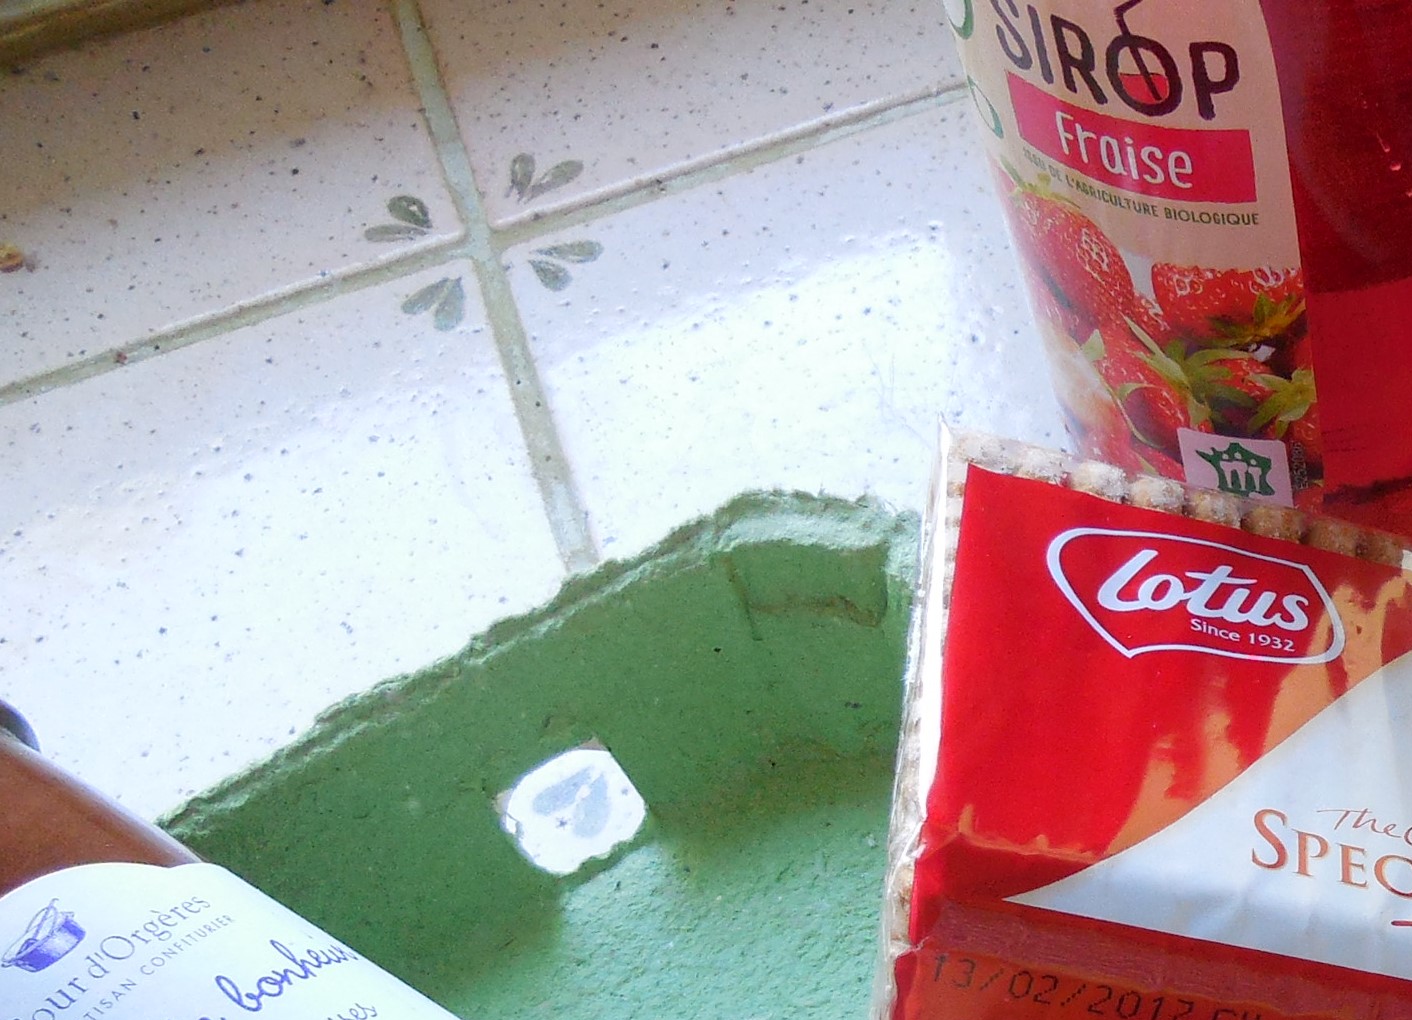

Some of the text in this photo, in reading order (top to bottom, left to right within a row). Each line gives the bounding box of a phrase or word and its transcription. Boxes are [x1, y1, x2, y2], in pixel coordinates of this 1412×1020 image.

[997, 0, 1240, 121] SIROP
[1055, 111, 1193, 189] Fraise
[1065, 175, 1160, 218] L'AGRICULTURE
[1165, 206, 1260, 226] BIOLOGIQUE
[1097, 548, 1310, 632] Lotus
[1190, 618, 1296, 653] Since 1932
[1317, 807, 1402, 838] The
[86, 895, 212, 980] d'Orgères
[139, 913, 236, 976] CONFITURIER
[214, 938, 359, 1013] bonheur
